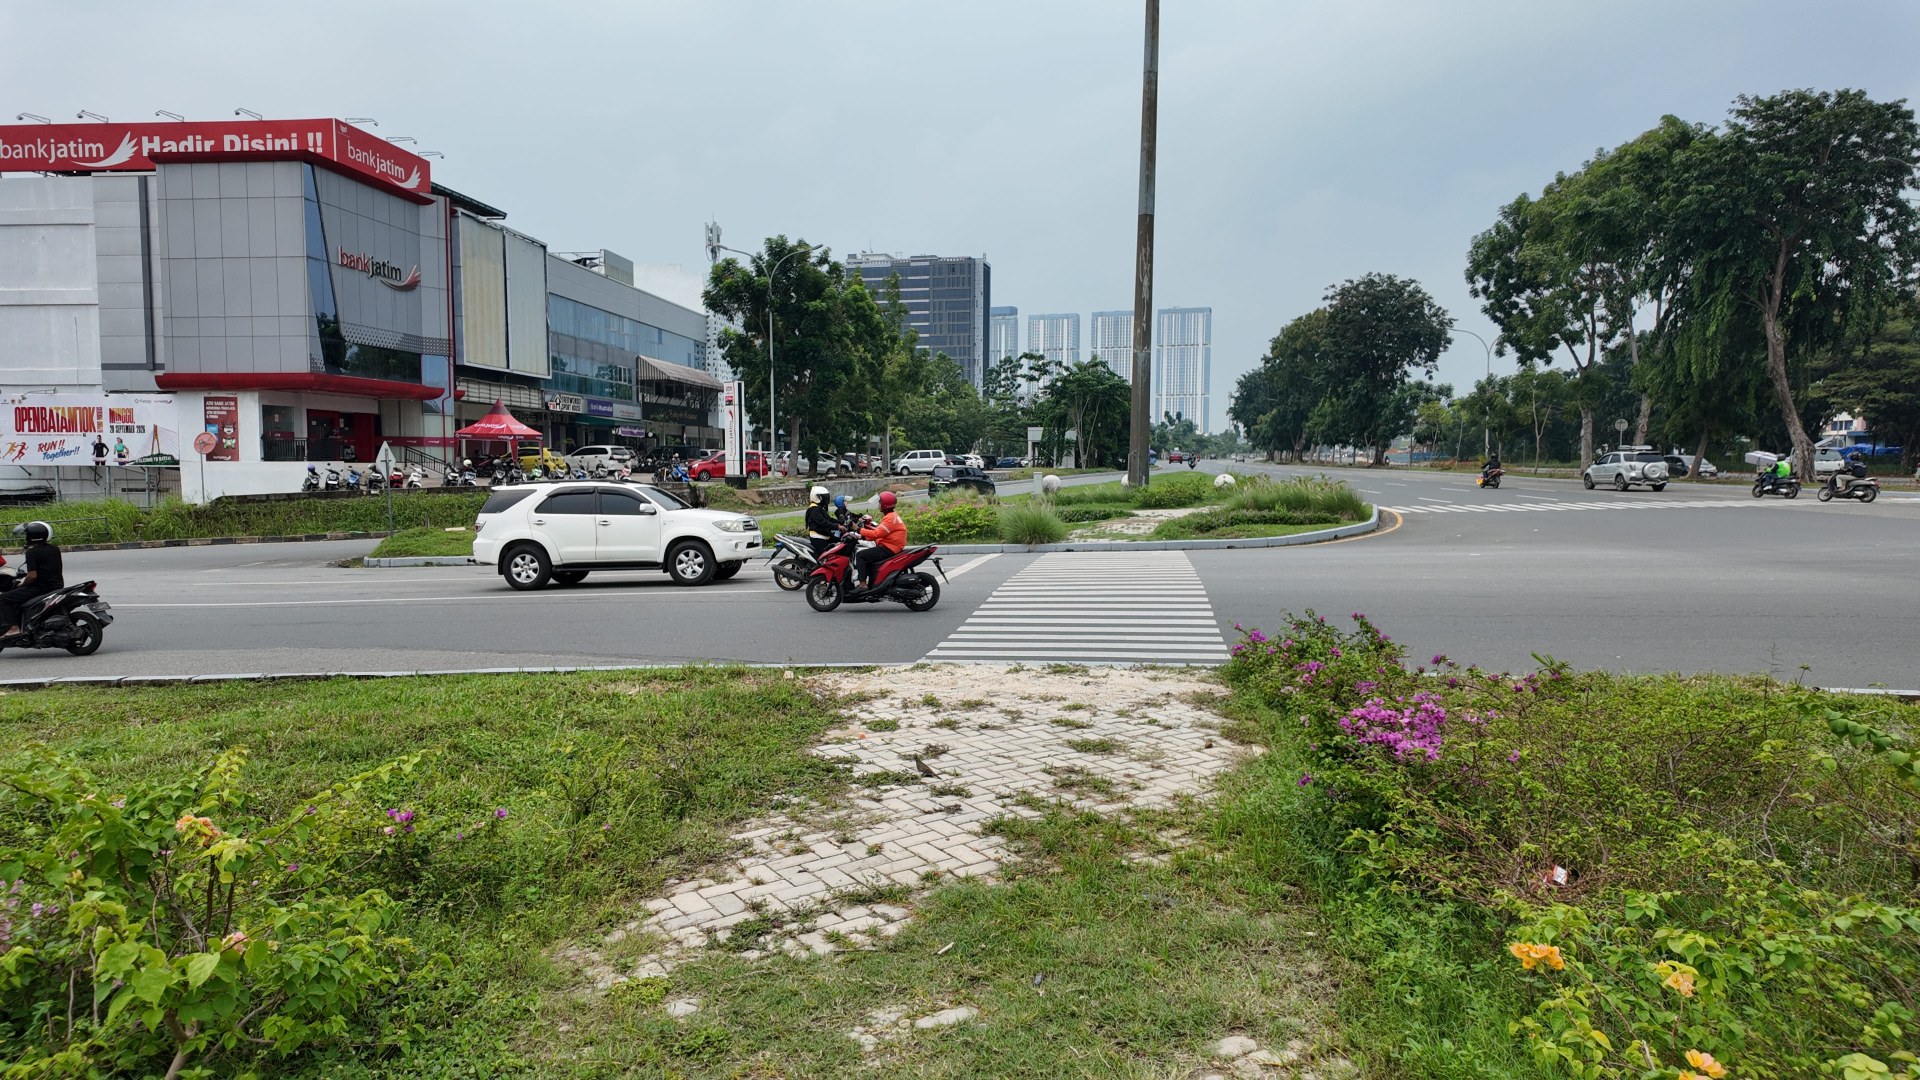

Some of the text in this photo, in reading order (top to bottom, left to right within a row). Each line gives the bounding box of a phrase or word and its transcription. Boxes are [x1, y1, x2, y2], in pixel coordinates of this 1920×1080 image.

[0, 138, 104, 164] bankjatim
[142, 135, 215, 156] Hadir
[223, 133, 298, 152] Disini
[347, 139, 405, 180] bankjatim
[337, 246, 402, 281] bankjatim
[115, 425, 135, 433] SEPTEMBER
